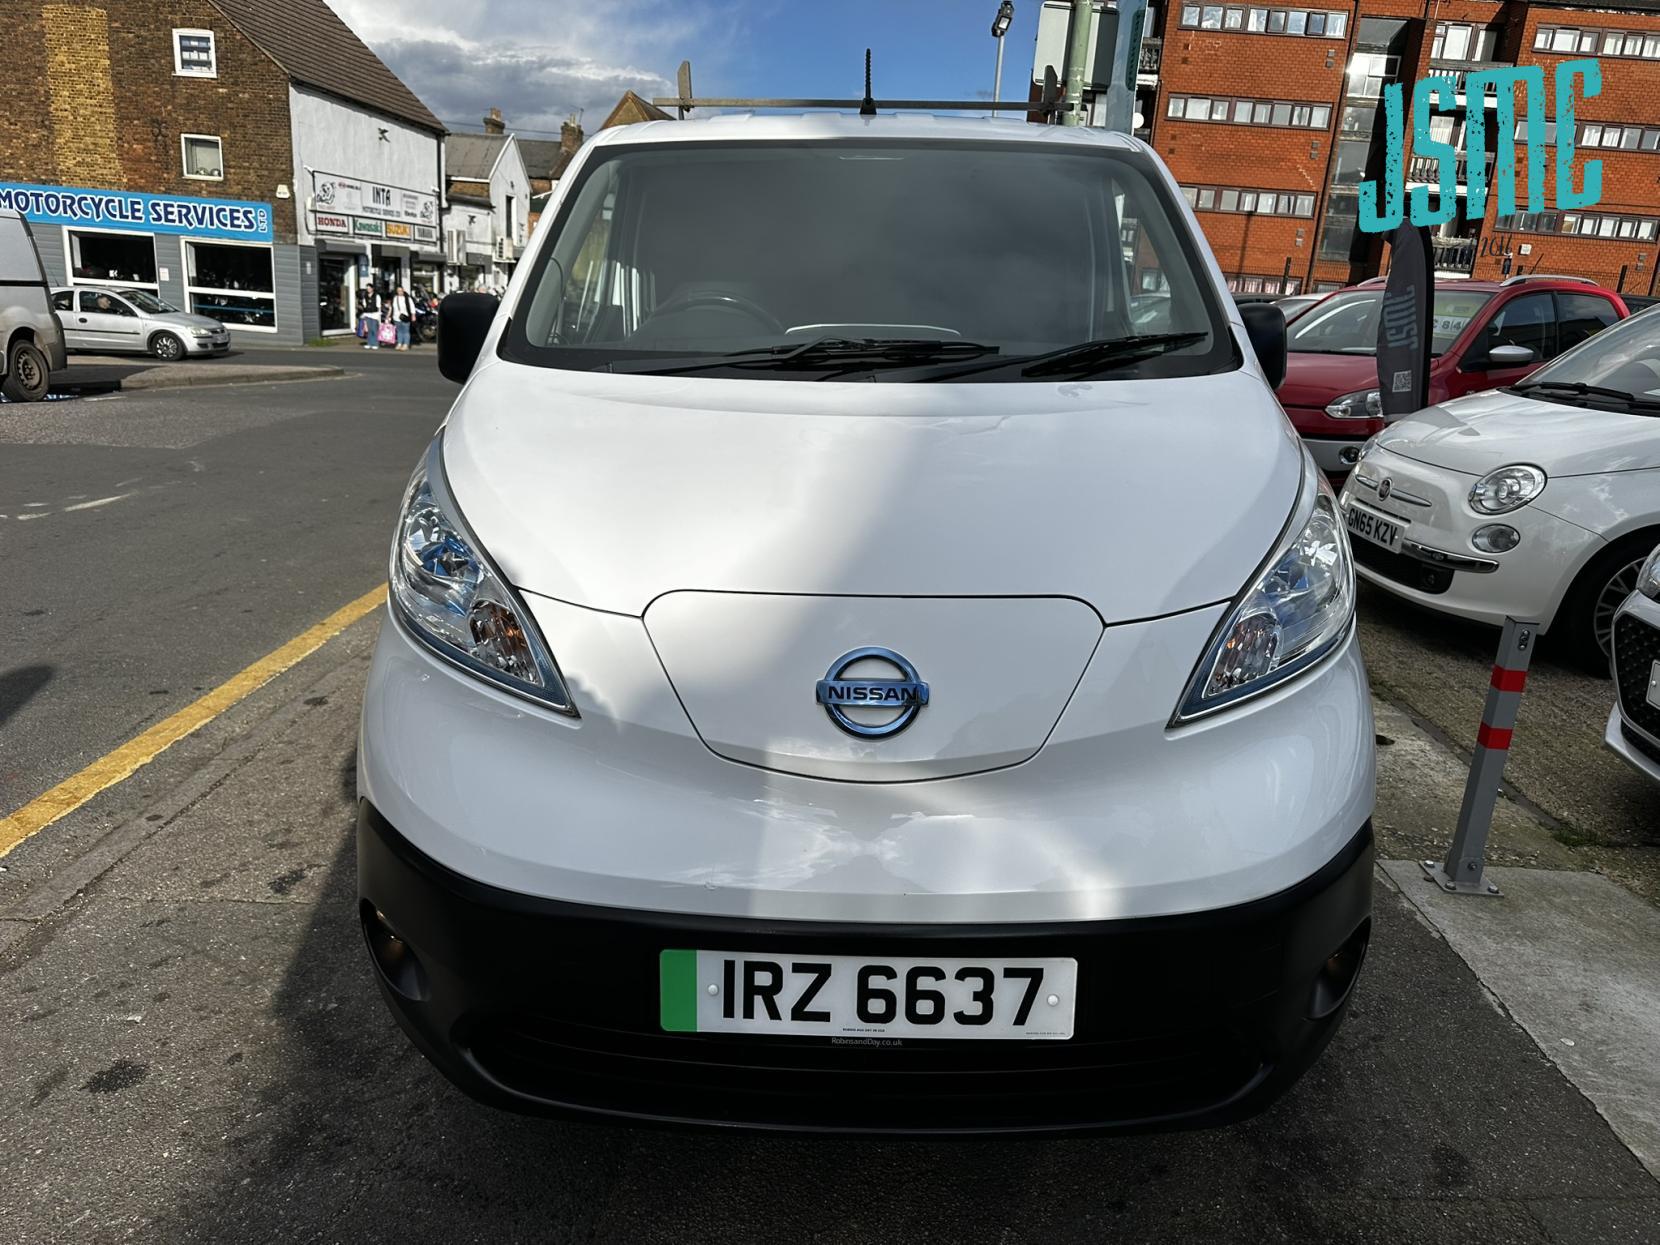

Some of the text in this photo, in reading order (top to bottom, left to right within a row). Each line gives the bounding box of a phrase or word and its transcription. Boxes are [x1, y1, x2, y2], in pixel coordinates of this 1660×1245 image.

[372, 186, 391, 207] INTA
[0, 188, 268, 232] MOTORCYCLE SERVICES LTD
[317, 216, 347, 228] HONDA
[354, 219, 383, 233] Kawasaki
[387, 223, 411, 237] SUZUKI
[1348, 507, 1398, 546] GN65 KZV
[828, 686, 918, 701] NISSAN
[722, 959, 1045, 1026] IRZ 6637
